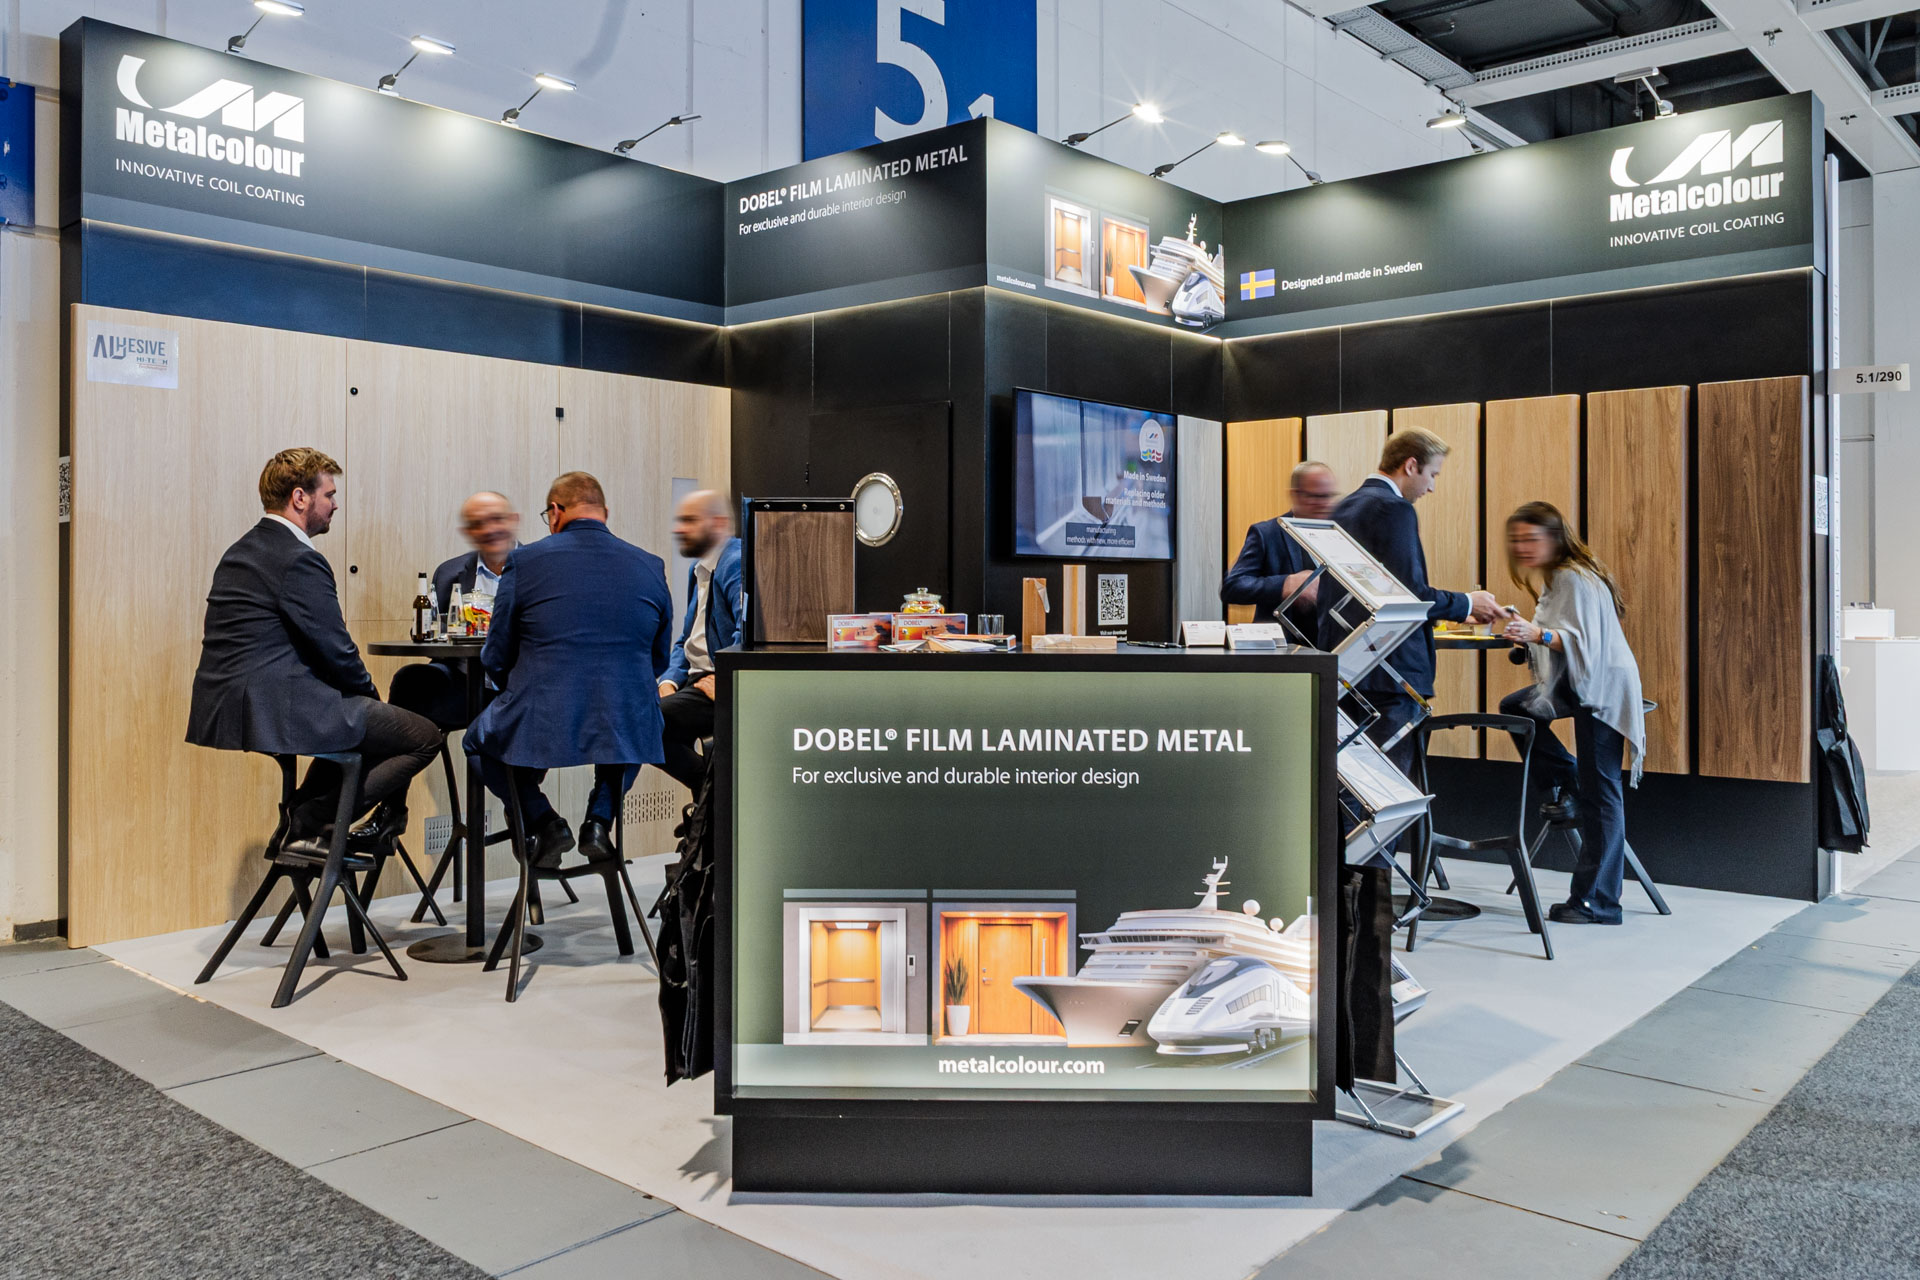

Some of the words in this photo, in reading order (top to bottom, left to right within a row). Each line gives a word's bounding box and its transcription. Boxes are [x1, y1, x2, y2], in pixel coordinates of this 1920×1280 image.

[116, 107, 305, 178] Metalcolour
[115, 158, 205, 187] INNOVATIVE
[209, 177, 242, 195] COIL
[245, 184, 305, 207] COATING
[790, 179, 822, 202] FILM
[825, 158, 911, 193] LAMINATED
[915, 144, 968, 173] METAL
[1609, 171, 1784, 222] Metalcolour
[739, 223, 752, 236] For
[752, 216, 789, 233] exclusive
[789, 210, 806, 224] and
[807, 203, 840, 220] durable
[842, 196, 873, 213] interior
[876, 189, 907, 207] design
[1610, 226, 1685, 248] INNOVATIVE
[1689, 222, 1720, 236] COIL
[1723, 211, 1785, 232] COATING
[996, 274, 1036, 290] metalcolour.com
[1281, 274, 1324, 292] Designed
[1325, 272, 1343, 285] and
[1344, 267, 1372, 282] made
[1373, 265, 1383, 278] in
[1384, 261, 1423, 277] Sweden
[1856, 370, 1902, 384] 5.1/290
[1123, 470, 1139, 480] Made
[1145, 472, 1167, 483] Sweden
[1105, 497, 1131, 506] materials
[1131, 498, 1142, 507] and
[1142, 500, 1166, 509] methods
[1124, 487, 1150, 500] Replacing
[1150, 490, 1165, 500] older
[1086, 526, 1117, 536] manufacturing
[793, 728, 898, 751] DOBEL®
[906, 728, 973, 751] FILM
[981, 728, 1149, 752] LAMINATED
[1157, 729, 1252, 752] METAL
[792, 766, 820, 784] For
[824, 766, 901, 784] exclusive
[906, 766, 939, 784] and
[944, 766, 1010, 784] durable
[1015, 767, 1077, 785] interior
[1081, 767, 1140, 789] design
[938, 1055, 1105, 1074] metalcolour.com
